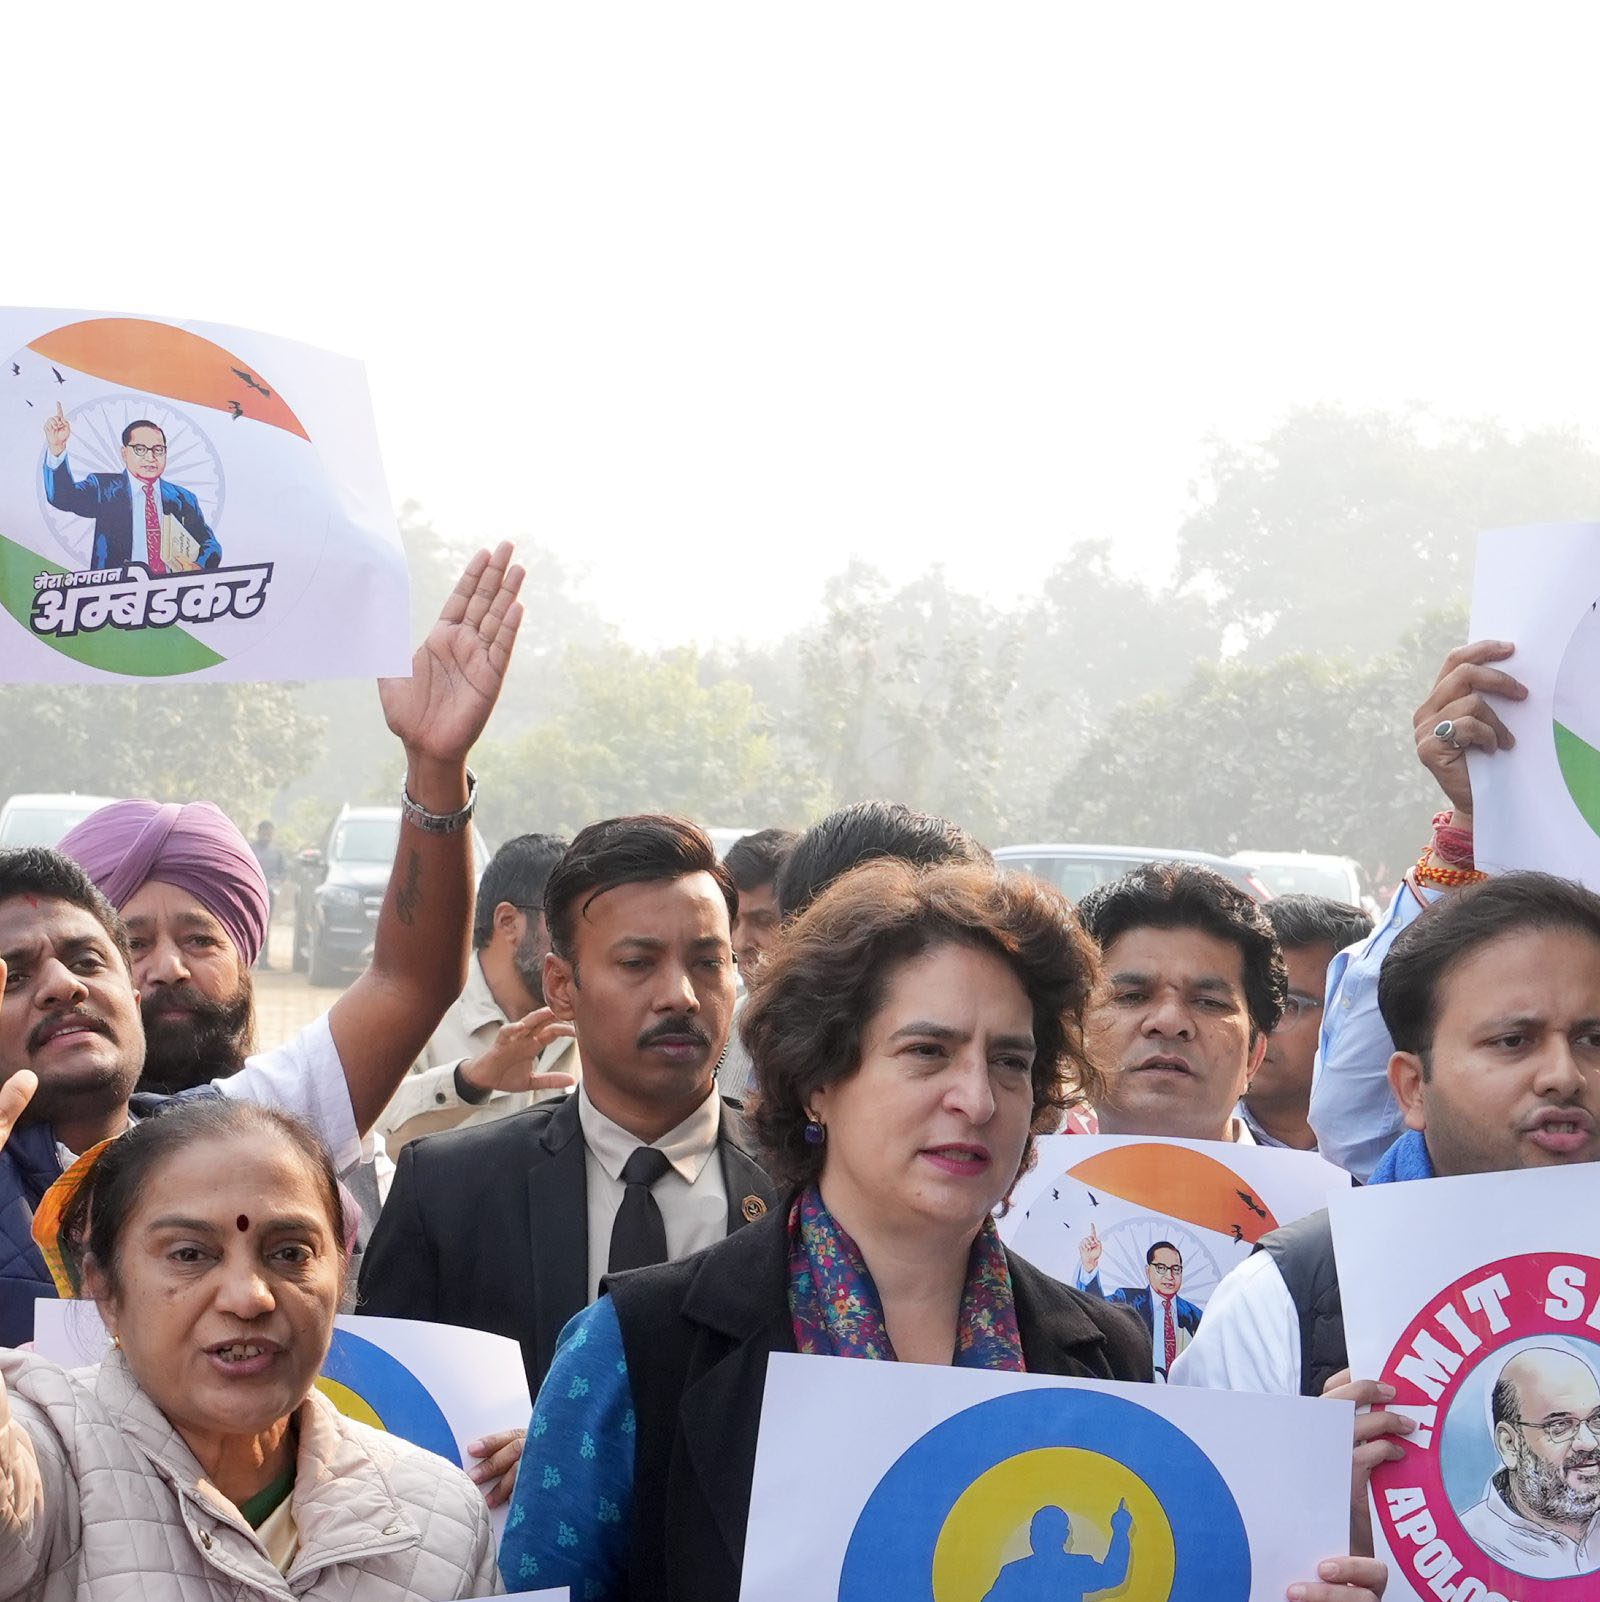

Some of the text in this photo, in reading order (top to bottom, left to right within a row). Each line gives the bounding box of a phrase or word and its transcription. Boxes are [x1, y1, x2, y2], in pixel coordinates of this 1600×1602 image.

[32, 565, 271, 634] अम्बेडकर
[33, 567, 123, 590] मेरा भगवान
[1385, 1271, 1512, 1450] AMIT
